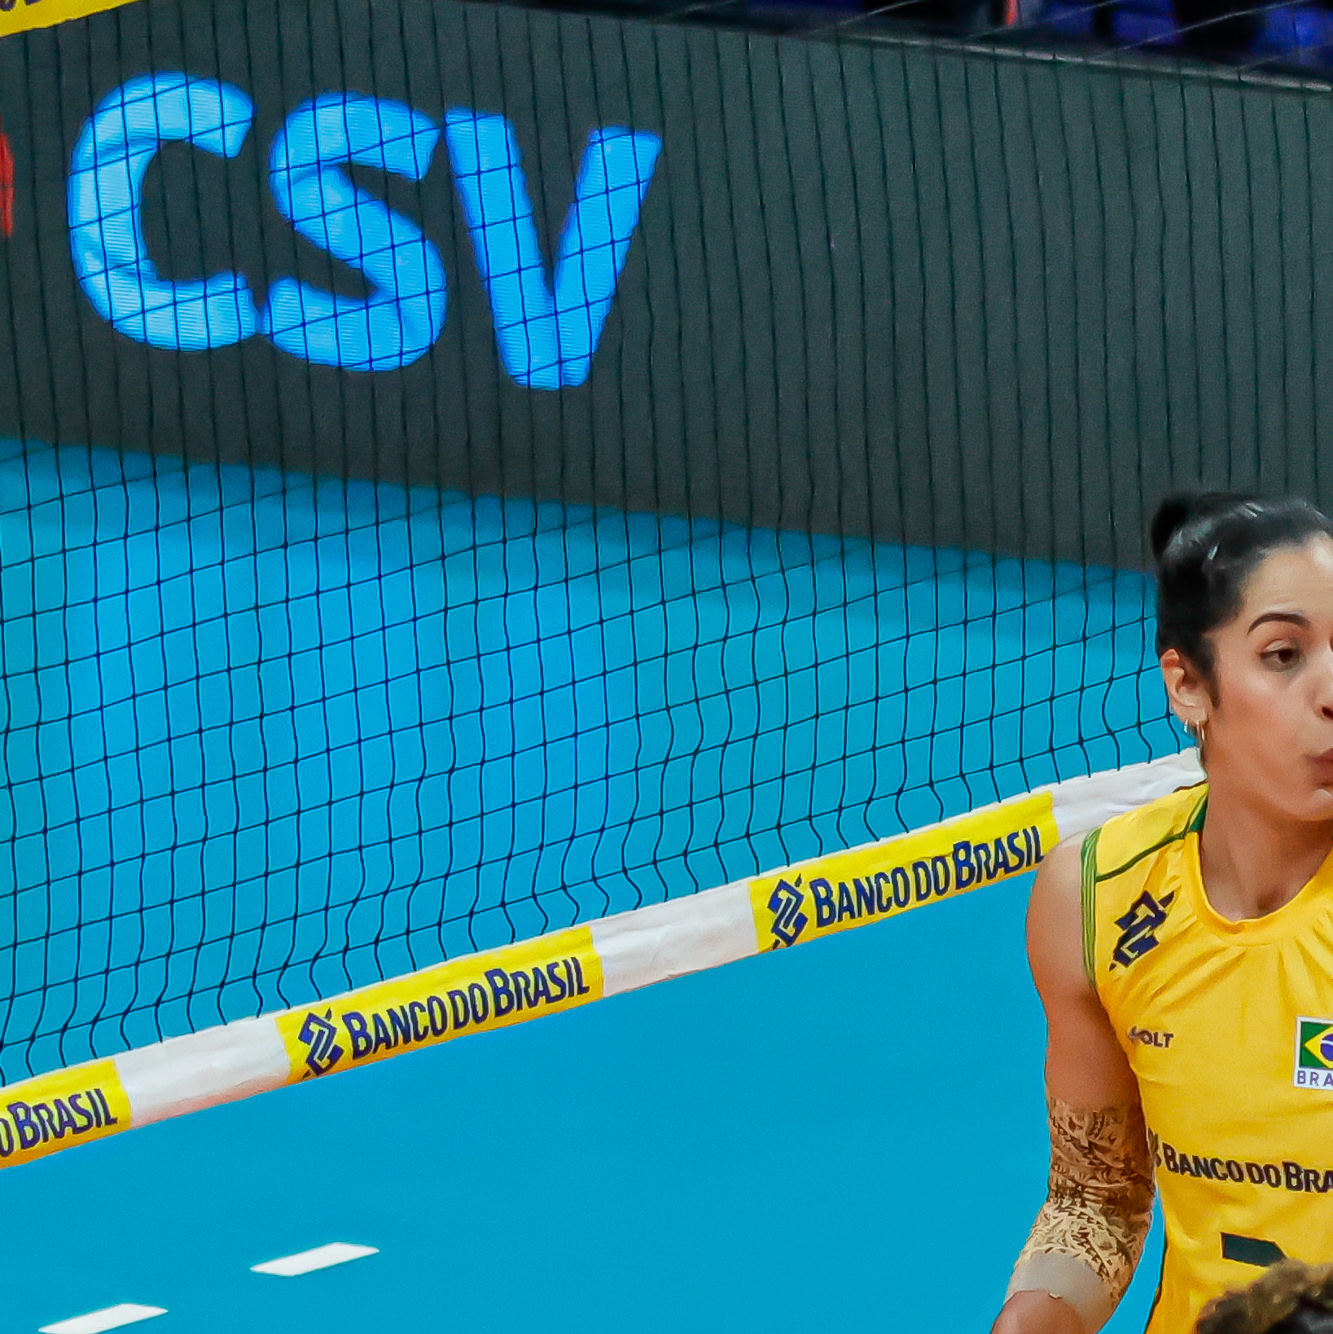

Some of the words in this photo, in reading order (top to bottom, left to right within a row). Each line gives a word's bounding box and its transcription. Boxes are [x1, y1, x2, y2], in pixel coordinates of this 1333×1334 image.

[68, 70, 662, 390] CSV
[810, 866, 912, 928] BANCO
[912, 855, 951, 902] DO
[952, 825, 1046, 890] BRASIL
[341, 995, 449, 1060] BANCO
[446, 982, 490, 1030] DO
[484, 956, 590, 1018] BRASIL
[6, 1088, 118, 1150] BRASIL
[1161, 1142, 1245, 1183] BANCO
[1245, 1161, 1283, 1188] DO
